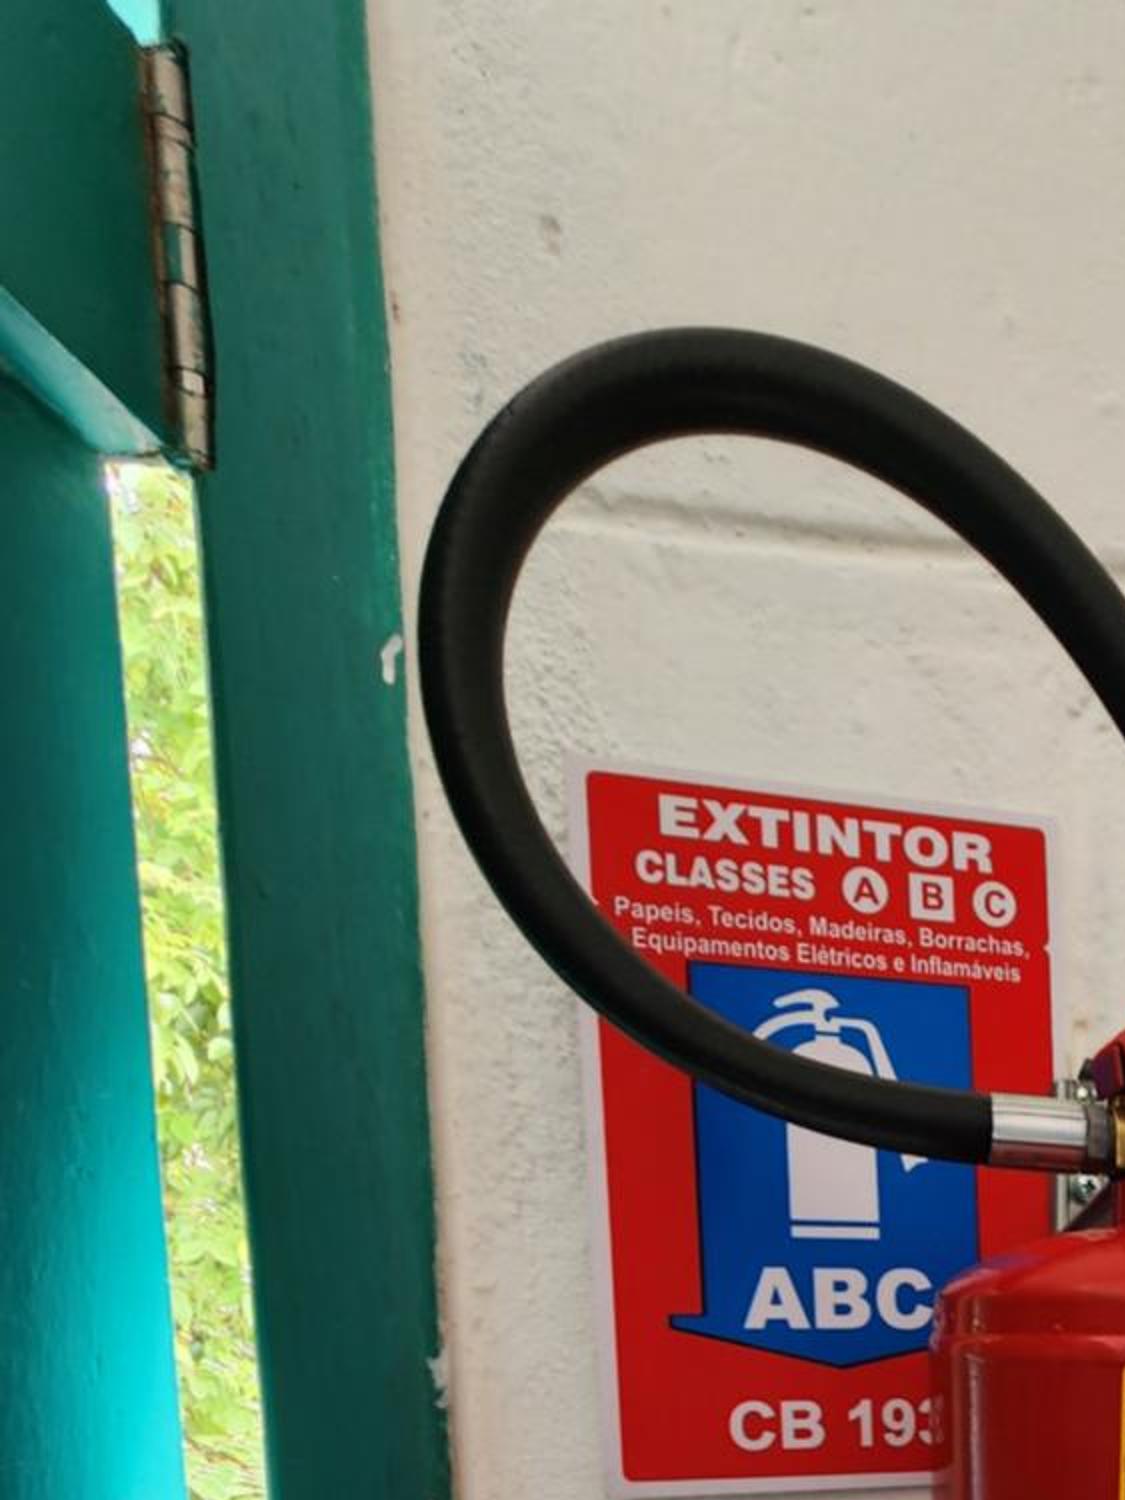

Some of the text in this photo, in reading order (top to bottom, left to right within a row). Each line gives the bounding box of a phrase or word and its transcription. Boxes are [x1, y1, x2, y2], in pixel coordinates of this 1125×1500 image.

[659, 794, 993, 874] EXTINTOR
[635, 850, 815, 900] CLASSES
[614, 897, 1030, 959] Papeis, Tecidos, Madeiras, Borrachas,
[633, 928, 1021, 984] Equipamentos Elétricos e Inflamáveis
[744, 1267, 933, 1330] ABC
[729, 1399, 827, 1451] CB
